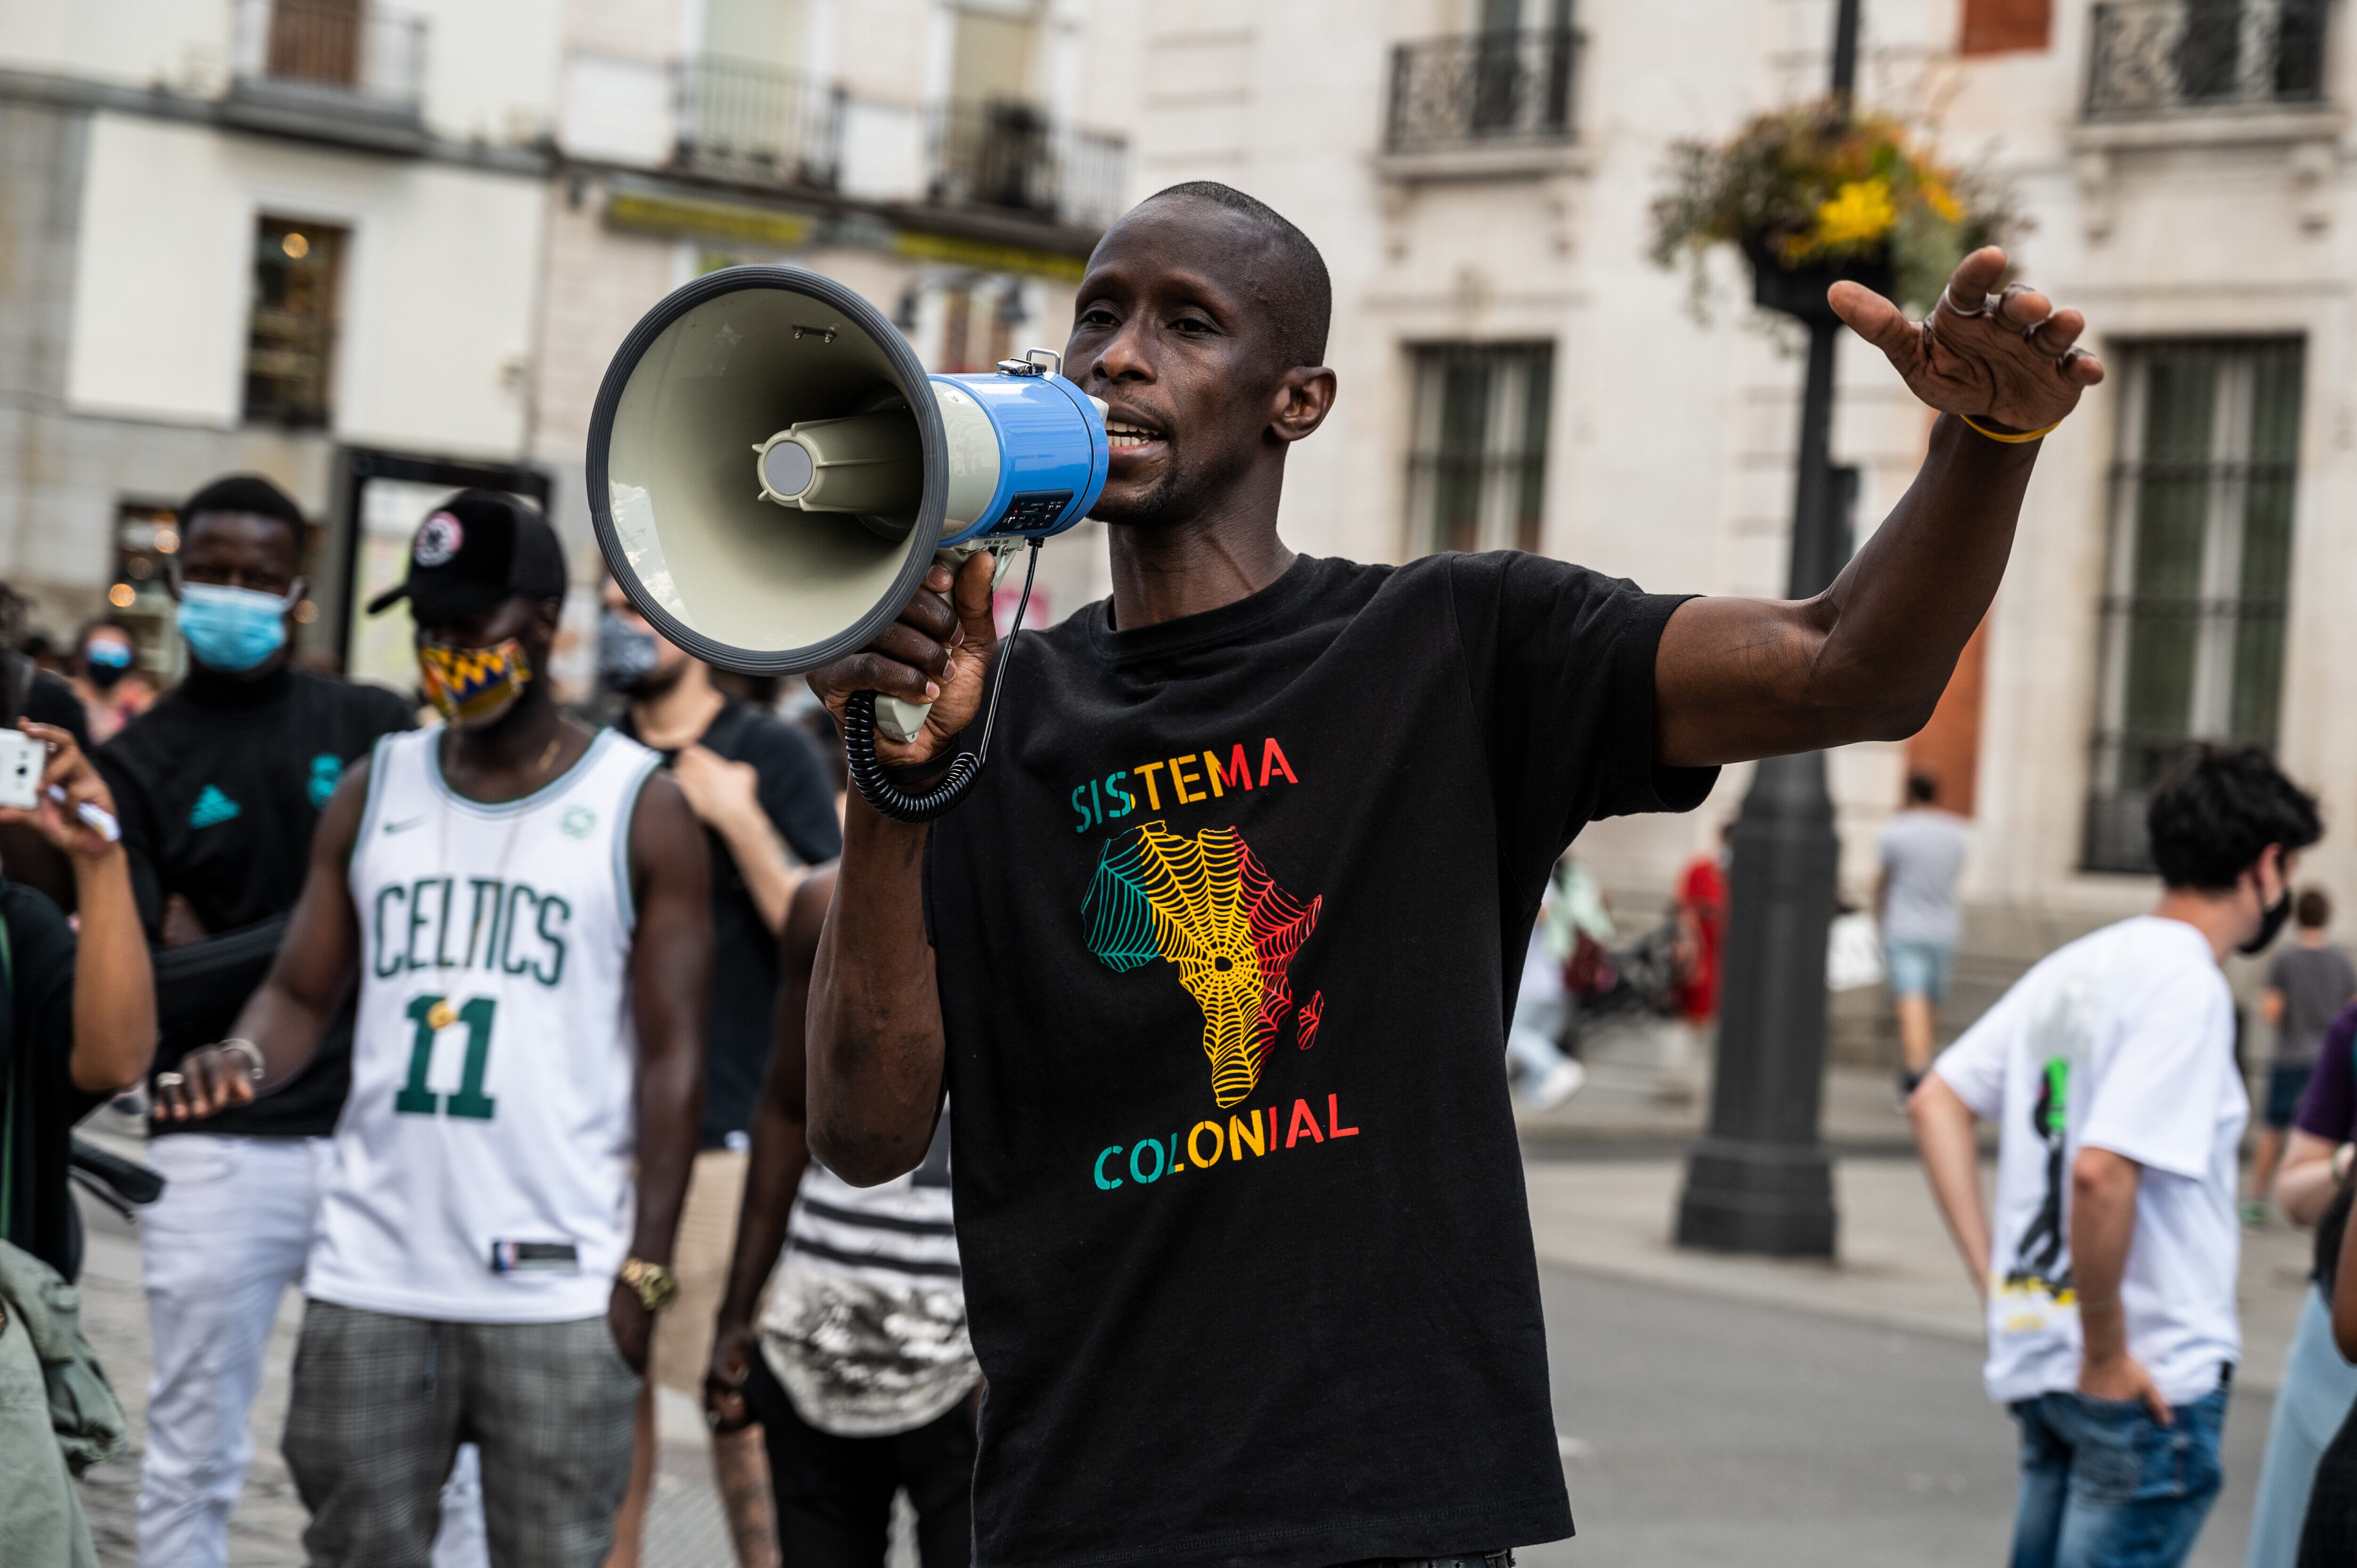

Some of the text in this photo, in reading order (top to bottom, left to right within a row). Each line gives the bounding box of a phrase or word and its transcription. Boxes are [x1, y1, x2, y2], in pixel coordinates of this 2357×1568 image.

[1072, 737, 1299, 833] SISTEMA
[374, 877, 571, 986] CELTICS
[394, 993, 496, 1121] 11
[1094, 1093, 1360, 1190] COLONIAL
